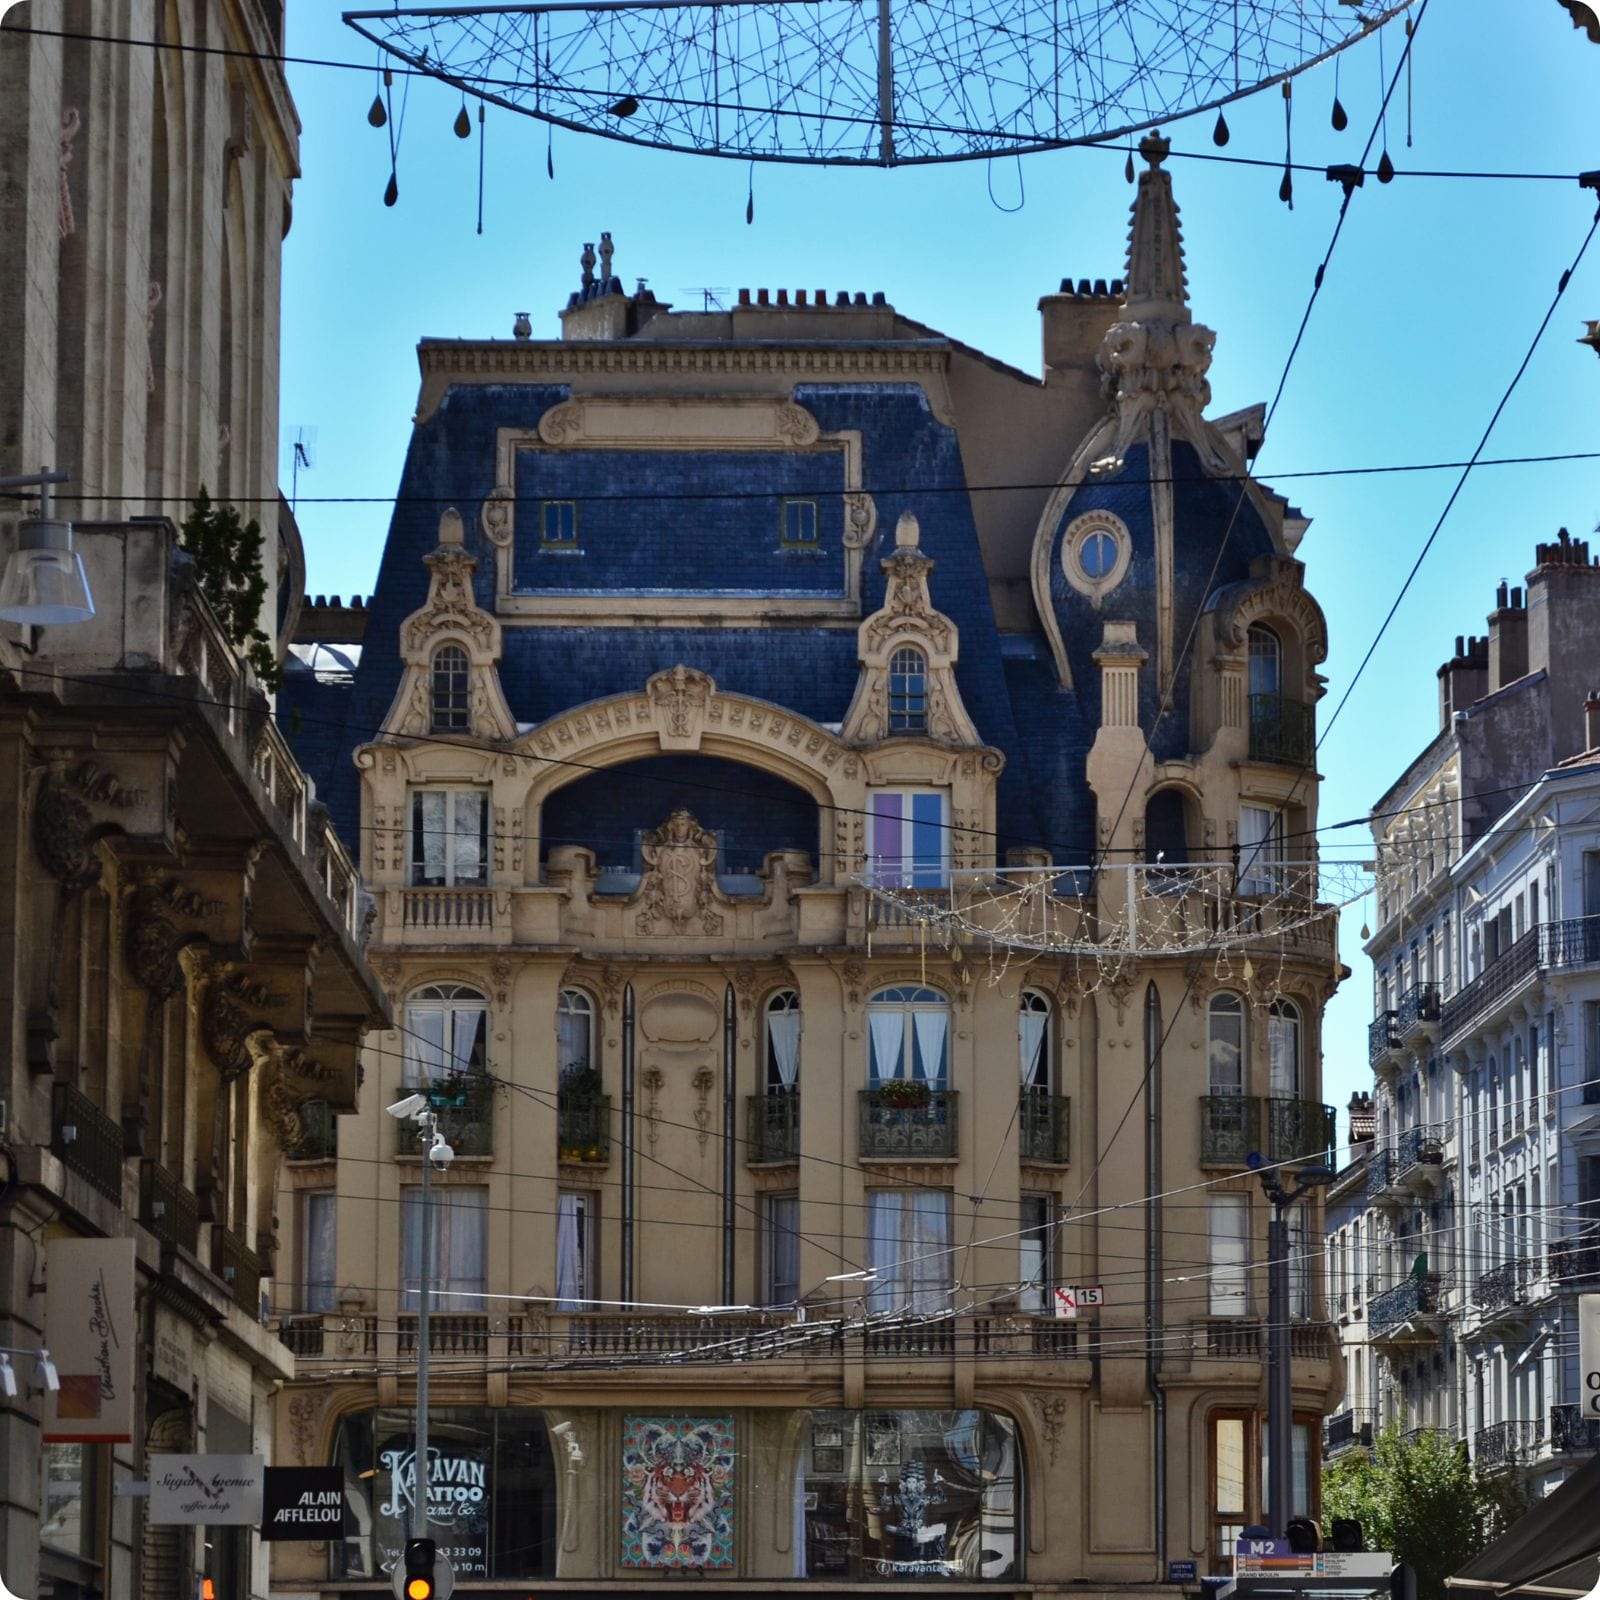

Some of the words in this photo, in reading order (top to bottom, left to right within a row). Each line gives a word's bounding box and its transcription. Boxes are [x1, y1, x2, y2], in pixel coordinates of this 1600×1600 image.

[1081, 1290, 1097, 1303] 15
[156, 1473, 196, 1490] Sugar
[211, 1473, 254, 1487] Avenue
[298, 1491, 341, 1505] ALAIN
[180, 1500, 207, 1513] coffee
[208, 1500, 231, 1513] shop
[426, 1502, 455, 1516] and
[274, 1508, 341, 1522] AFFLELOU
[453, 1547, 466, 1557] 33
[468, 1547, 482, 1557] 09
[1250, 1541, 1275, 1554] M2
[461, 1562, 472, 1571] 10
